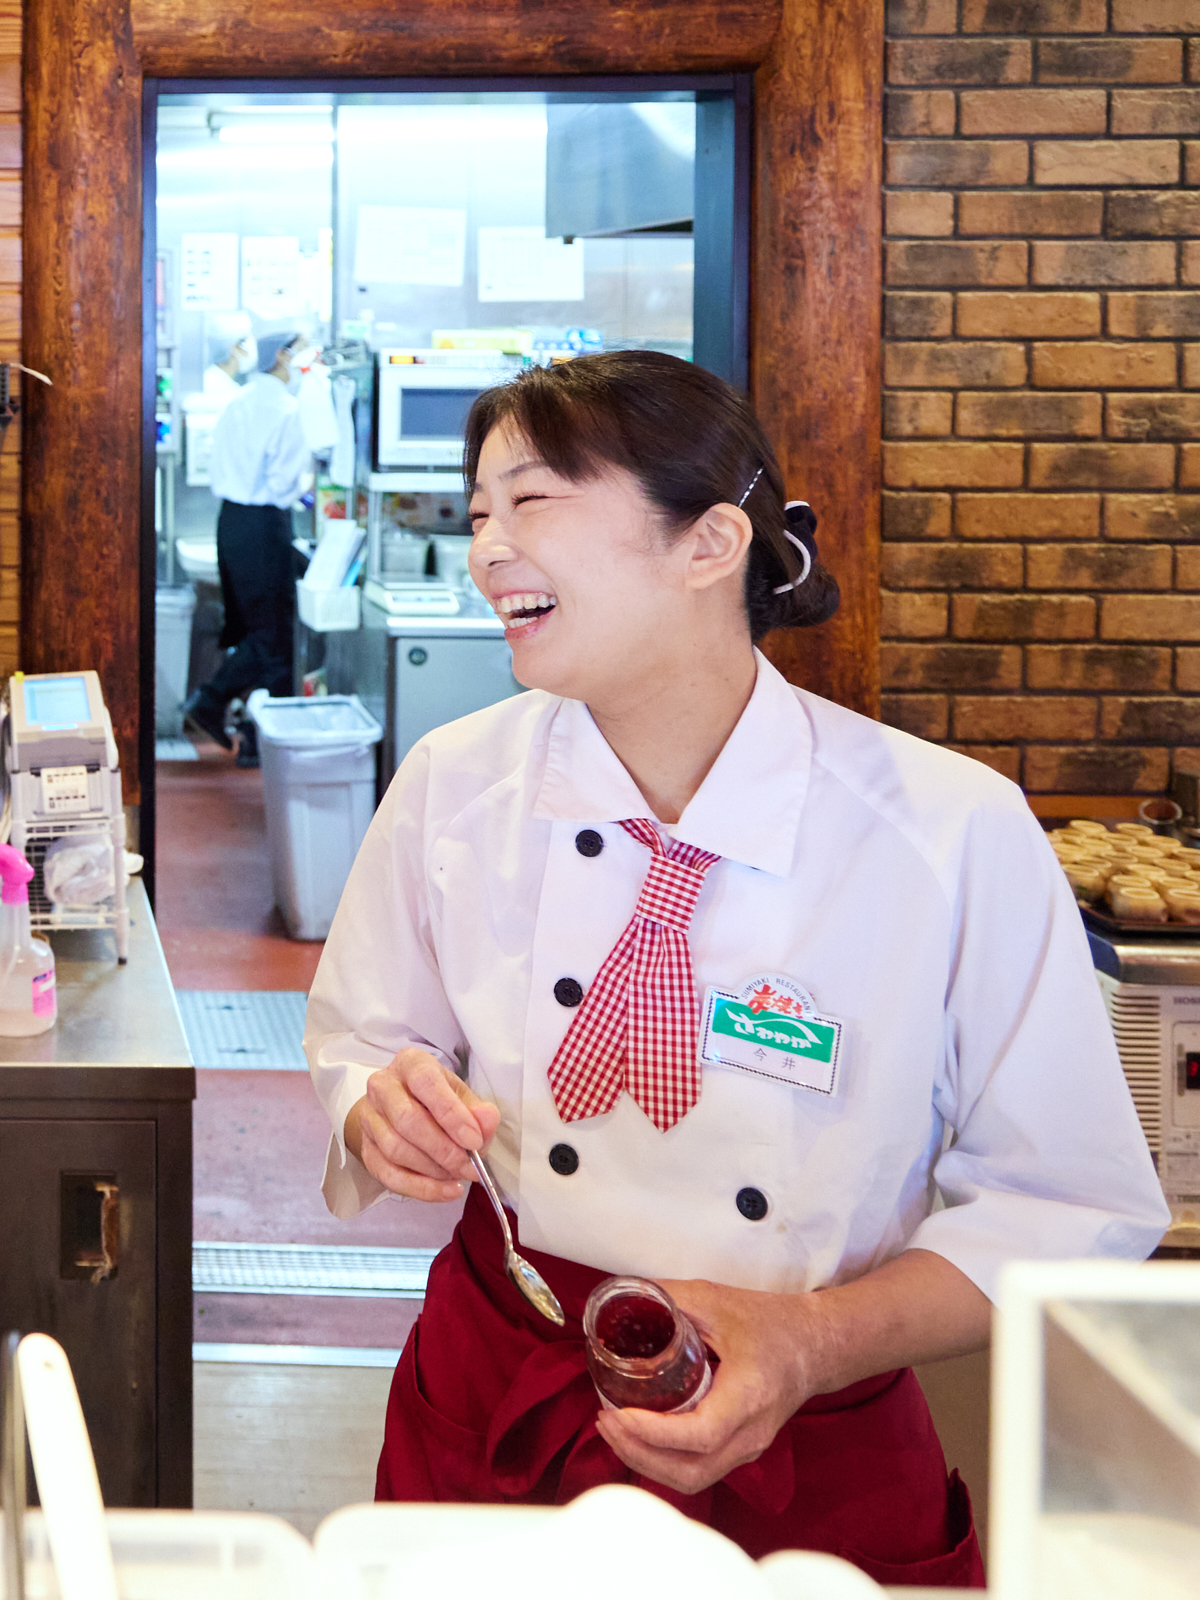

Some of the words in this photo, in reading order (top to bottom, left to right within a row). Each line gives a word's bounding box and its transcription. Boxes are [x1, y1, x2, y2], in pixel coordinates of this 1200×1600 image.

[741, 977, 770, 999] SUMIYAKI
[775, 978, 812, 1014] RESTAURANT
[748, 984, 804, 1019] 炭焼き
[725, 1007, 823, 1048] さわやか
[754, 1048, 796, 1070] 今井
